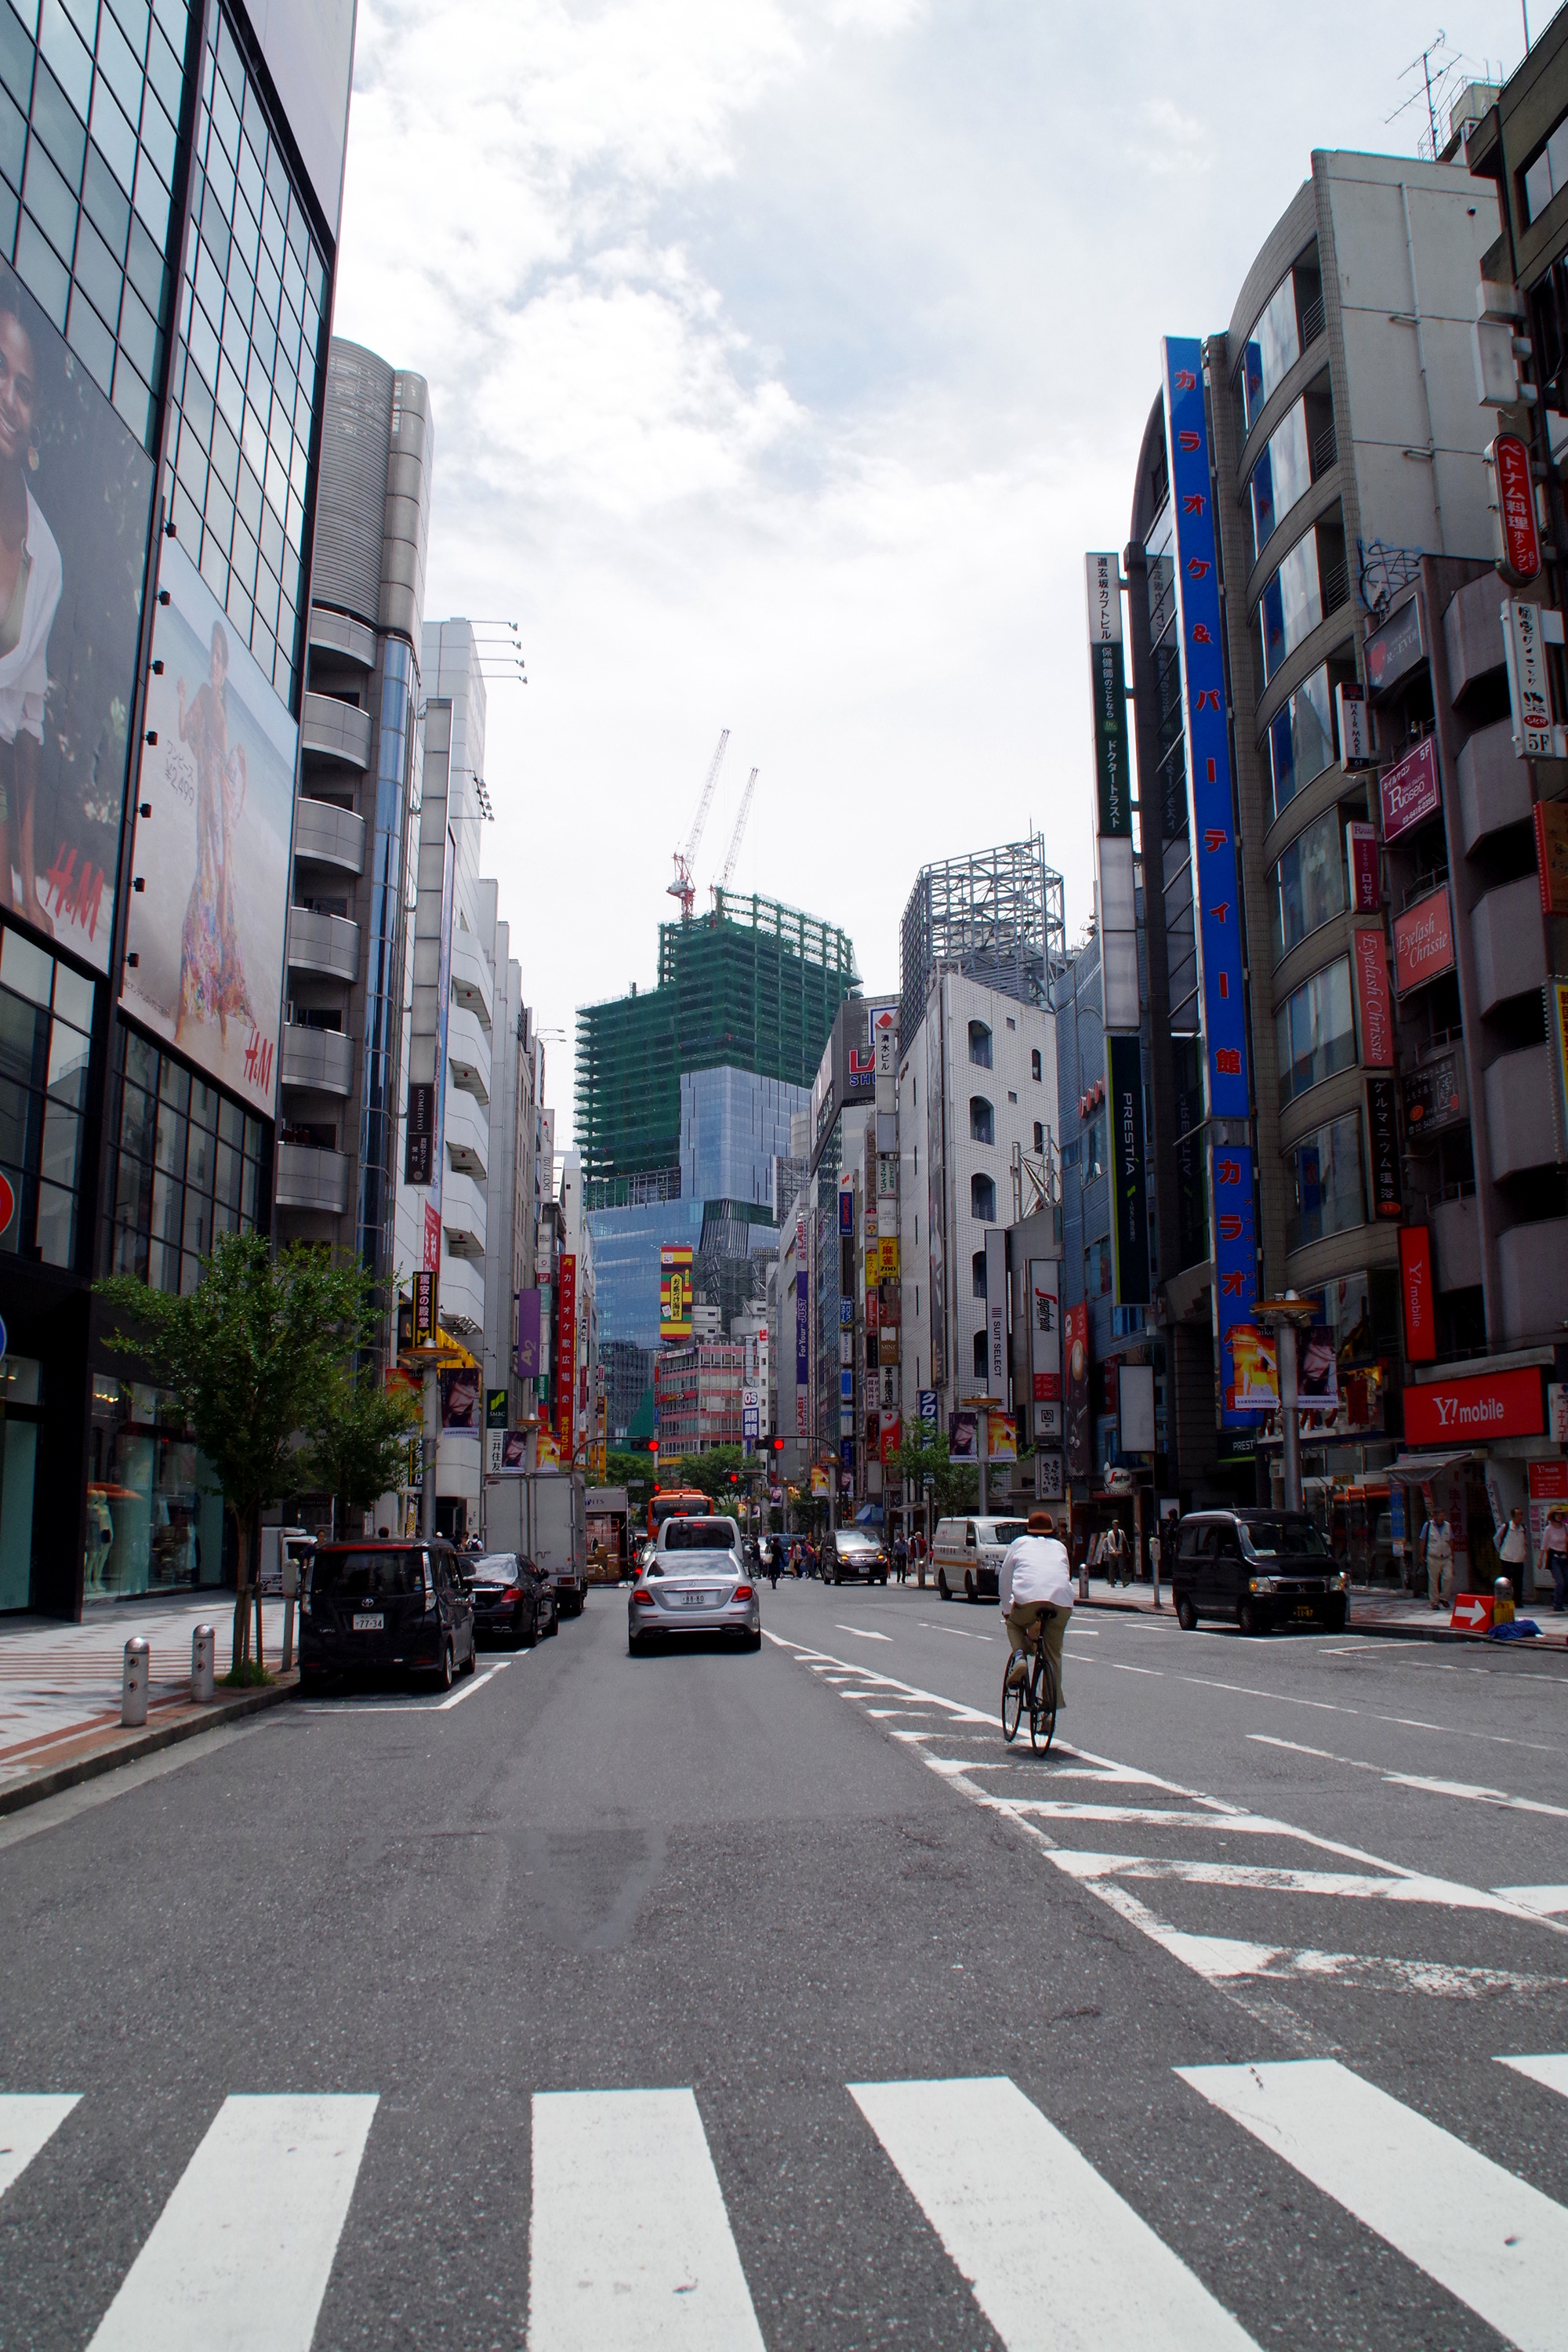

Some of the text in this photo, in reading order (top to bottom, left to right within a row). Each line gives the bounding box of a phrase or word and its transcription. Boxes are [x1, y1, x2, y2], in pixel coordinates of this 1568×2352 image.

[1499, 444, 1530, 531] ベトナム料理
[1097, 557, 1111, 640] 道玄坂カブトビル
[1350, 703, 1361, 757] HAIR MAKE
[1529, 734, 1548, 751] 5F
[166, 740, 194, 780] ワンピース
[1420, 745, 1430, 761] 5F
[1107, 740, 1120, 828] ドクタートラスト
[1383, 765, 1410, 791] ネイルサロン
[46, 840, 105, 942] H&M
[1362, 873, 1374, 906] ロゼオ
[1397, 913, 1448, 968] Eyelash Chrissie
[1359, 935, 1388, 1061] Eyelash Chrissie
[244, 1028, 274, 1097] H&M
[880, 1034, 890, 1071] 清水ビル
[416, 1088, 425, 1131] KOMEHYO
[411, 1146, 419, 1162] 受付
[1374, 1081, 1394, 1200] ゲルマニウム温浴
[1382, 1204, 1395, 1213] 3F
[882, 1246, 894, 1265] 麻雀
[419, 1274, 430, 1329] 驚安の殿堂
[797, 1298, 808, 1323] JUST
[1035, 1288, 1057, 1331] Segafredo
[1256, 1327, 1275, 1336] aiko
[993, 1343, 1002, 1377] SELECT
[745, 1392, 758, 1406] OS
[492, 1432, 503, 1474] 三井住友
[561, 1417, 570, 1453] 受付5F
